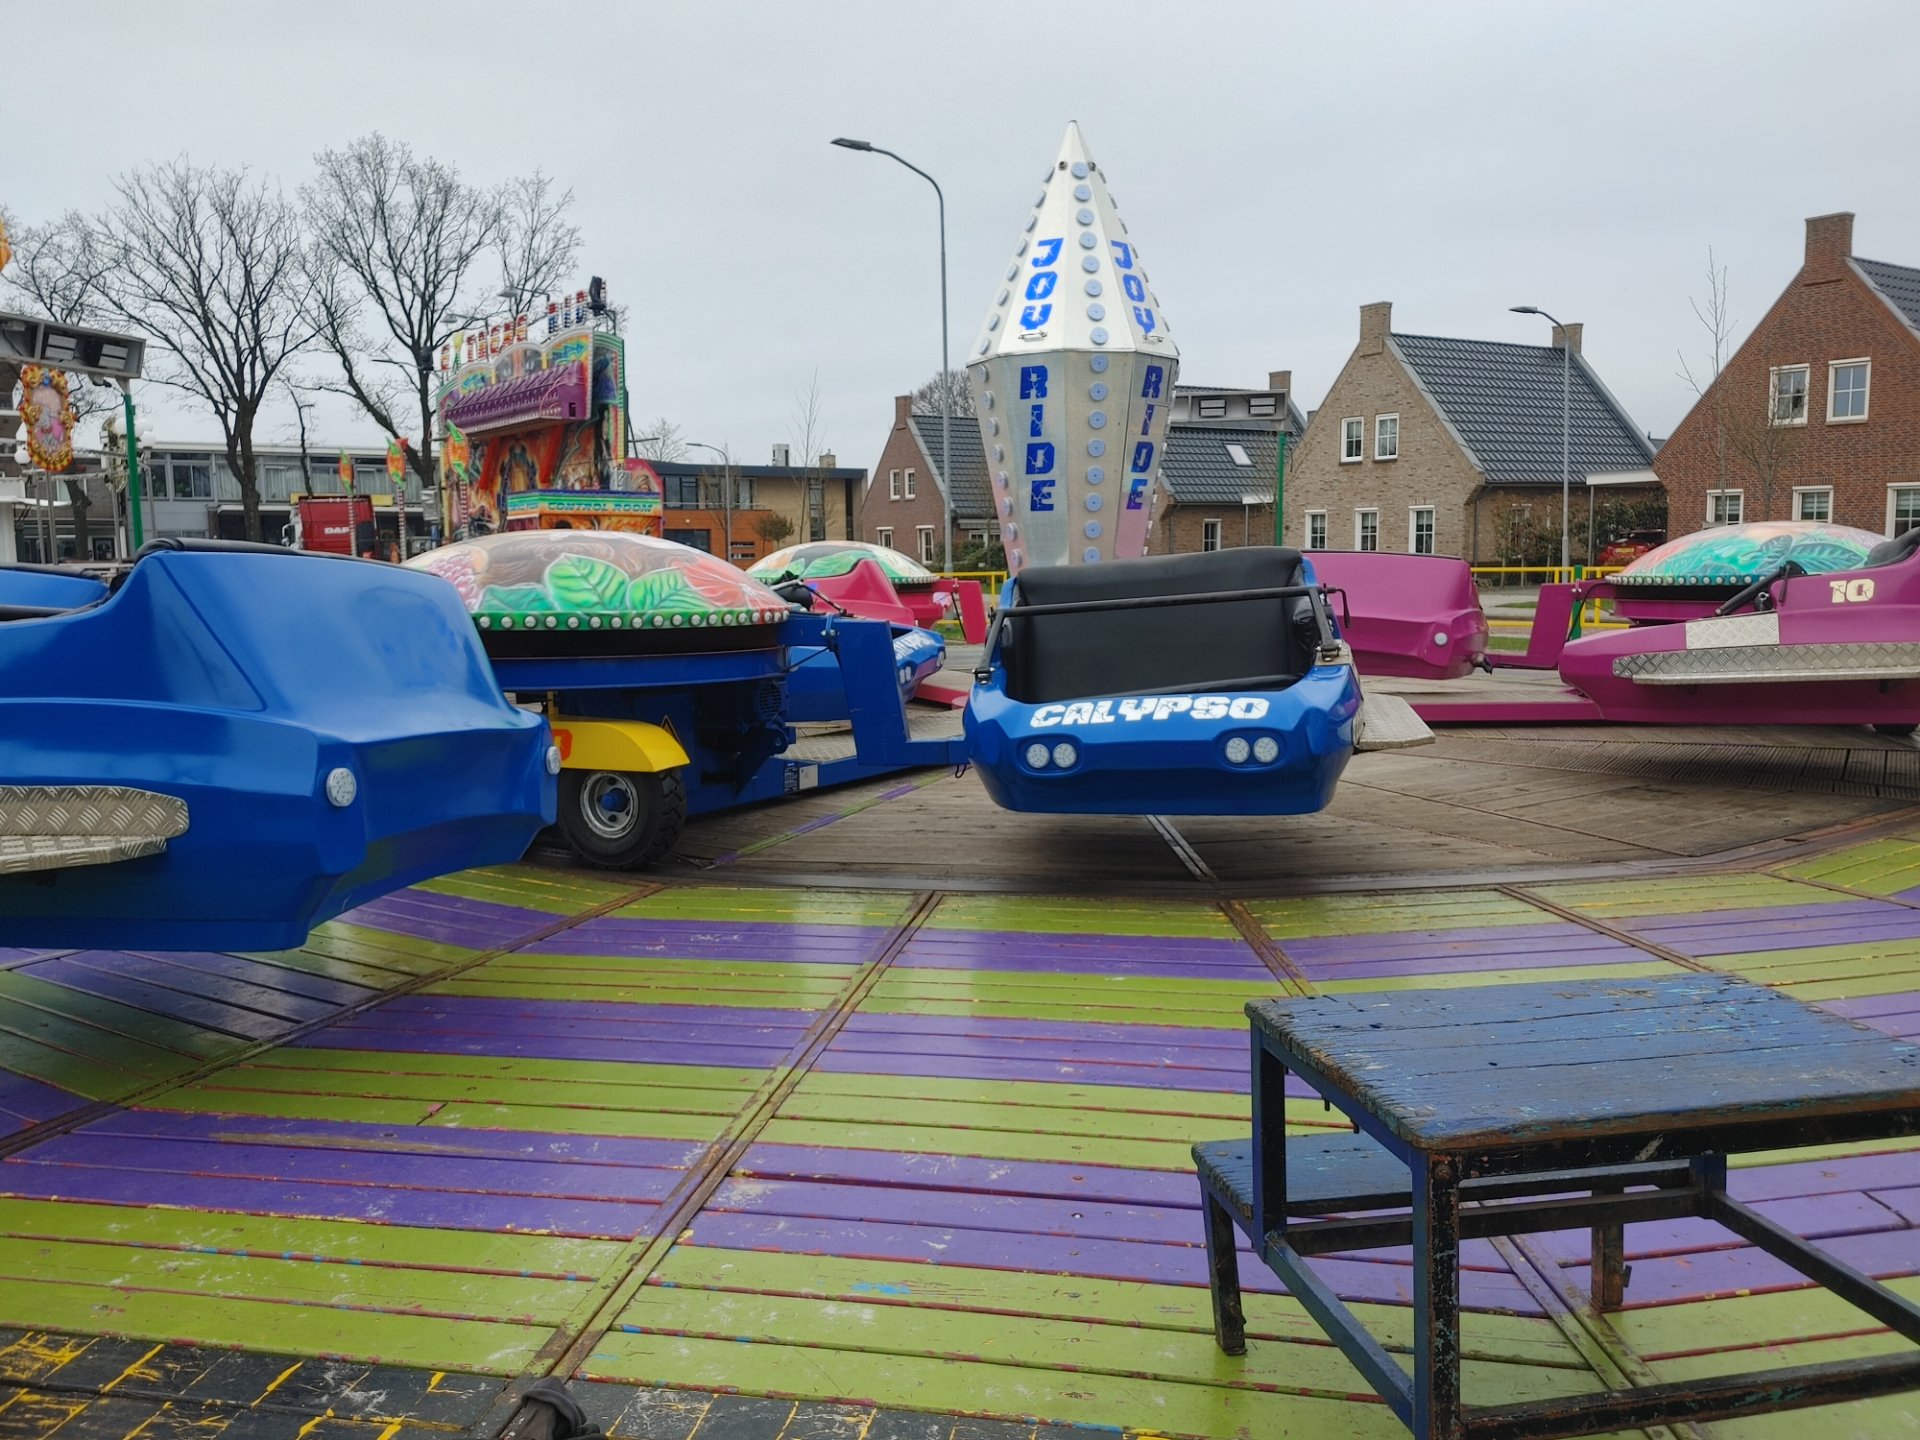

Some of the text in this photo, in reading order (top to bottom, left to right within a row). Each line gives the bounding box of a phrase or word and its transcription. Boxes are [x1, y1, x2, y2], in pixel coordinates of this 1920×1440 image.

[1019, 237, 1064, 512] JOY RIDE
[1110, 240, 1163, 511] JOY RIDE
[547, 502, 608, 512] CONTROL
[612, 503, 653, 513] ROOM
[324, 526, 350, 535] DAF
[1829, 578, 1875, 604] 10
[1030, 696, 1270, 728] CALYPSO
